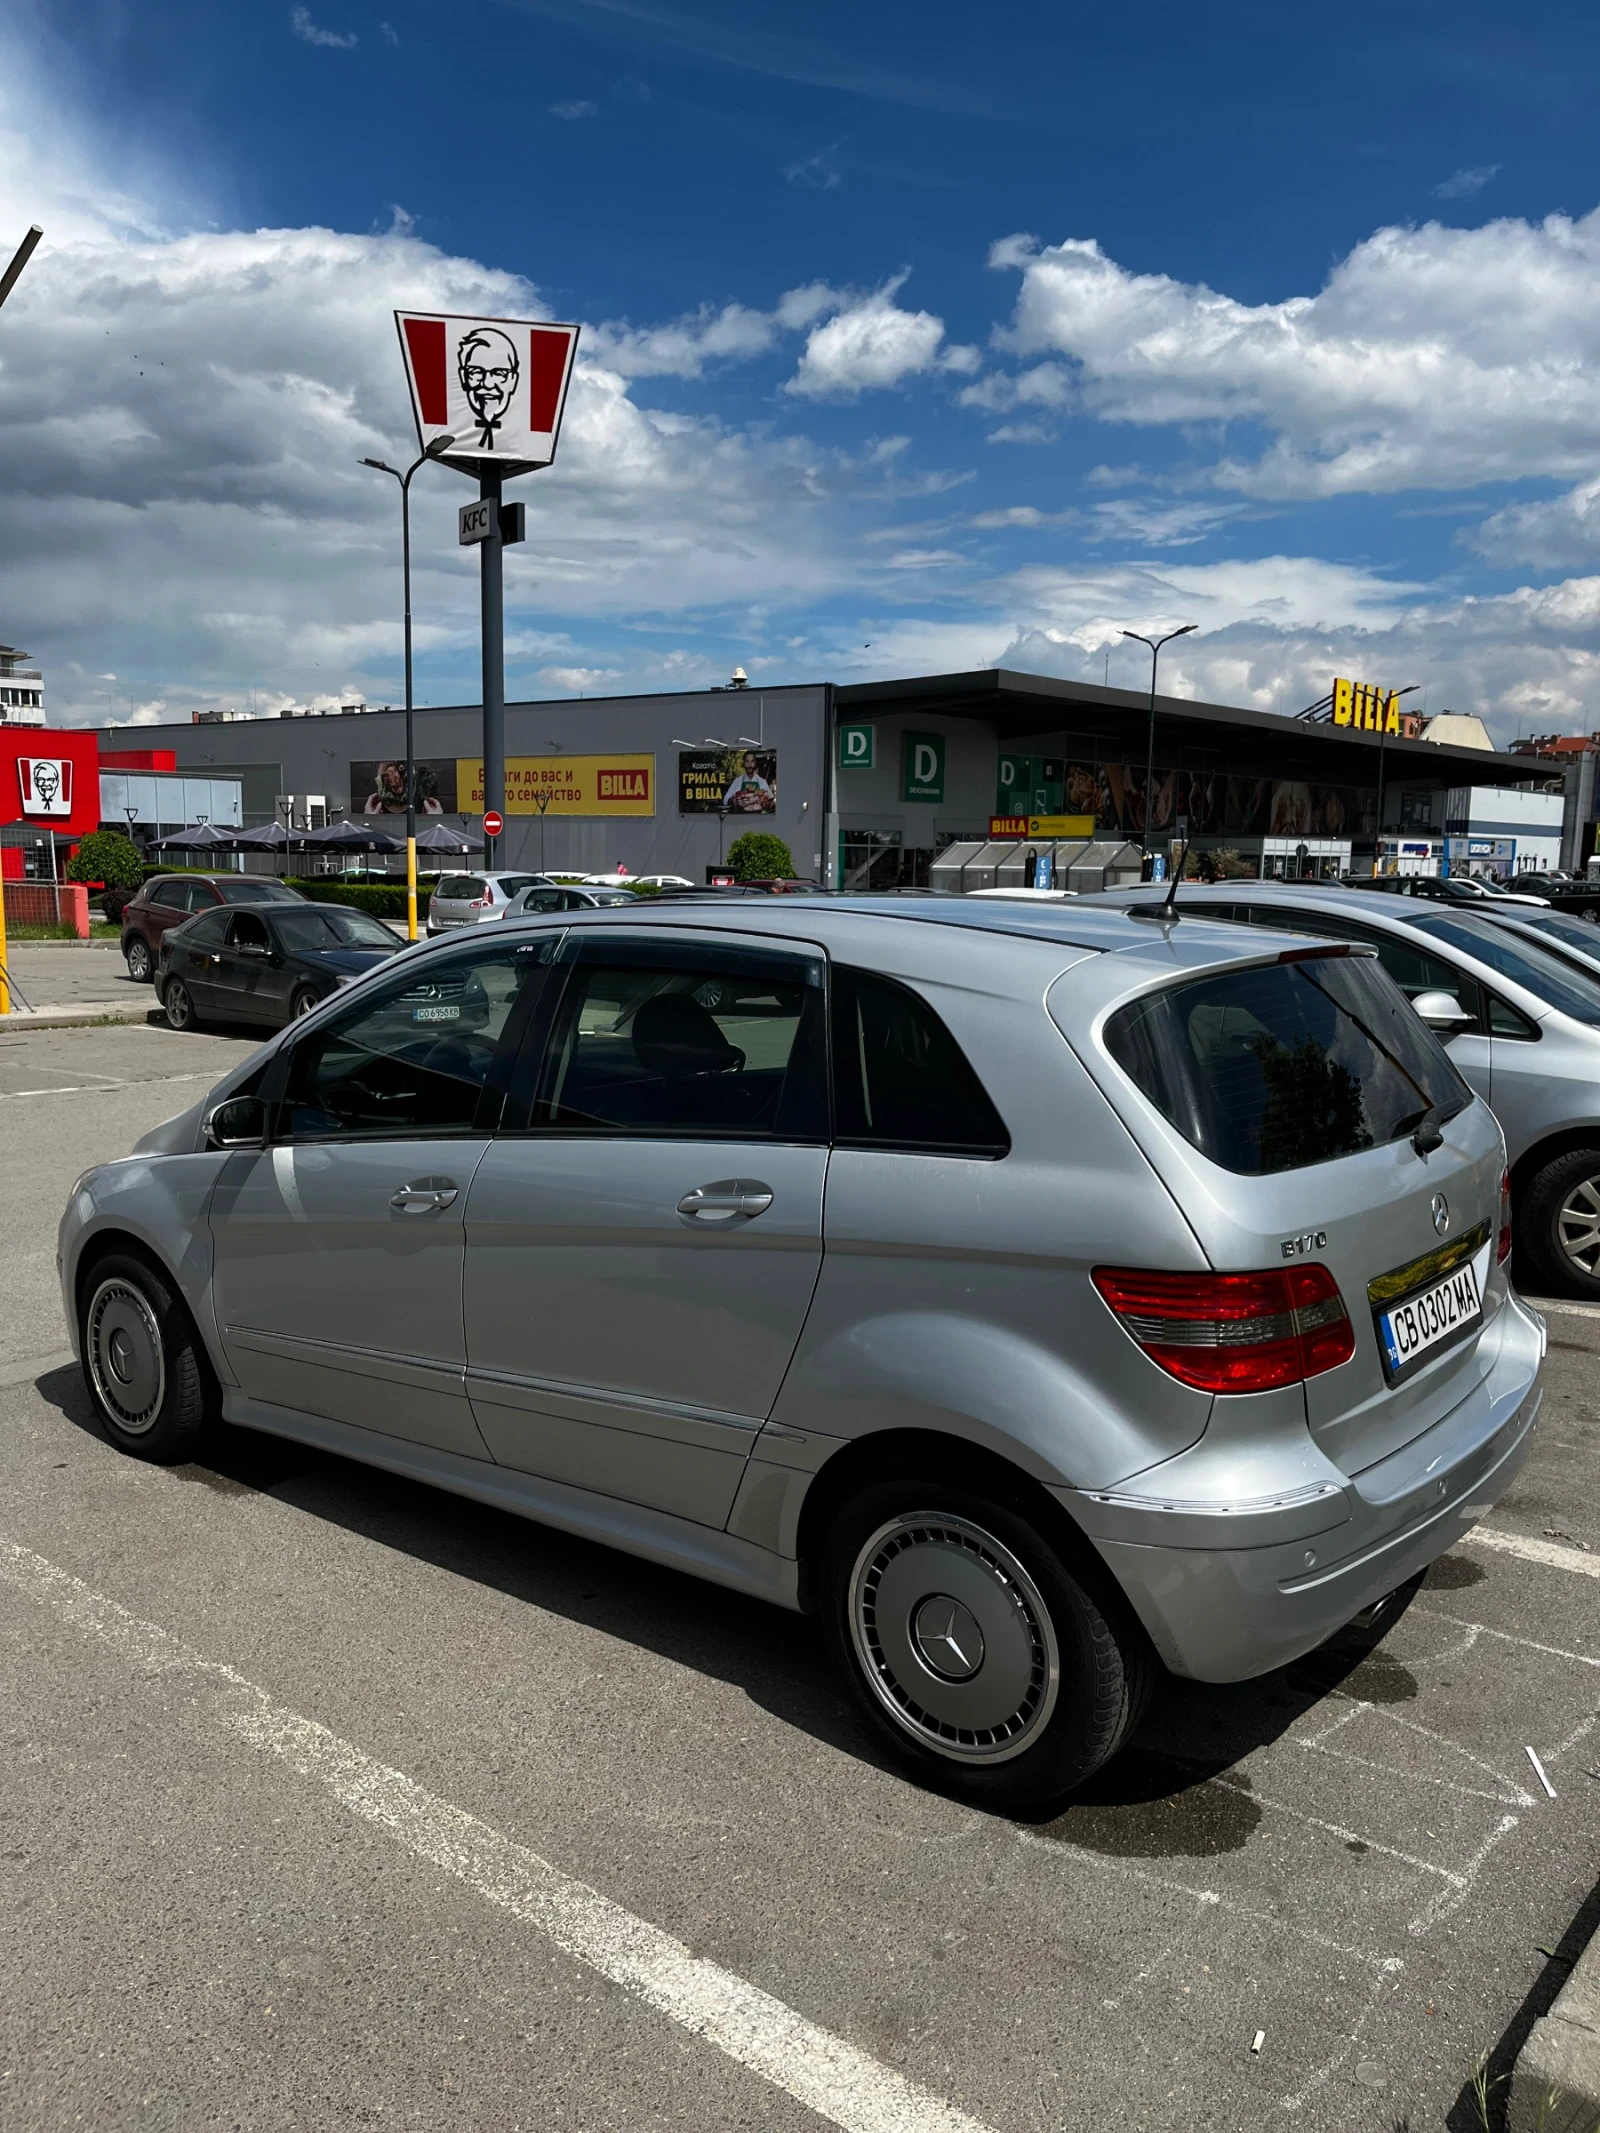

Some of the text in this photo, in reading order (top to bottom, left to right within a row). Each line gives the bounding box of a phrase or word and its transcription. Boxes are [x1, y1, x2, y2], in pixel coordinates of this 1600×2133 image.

[462, 507, 487, 534] KFC
[1332, 677, 1400, 734] BILLA
[848, 731, 867, 757] D
[915, 744, 938, 783] D
[1001, 760, 1015, 786] D
[524, 770, 539, 785] до
[541, 769, 562, 782] вас
[565, 770, 573, 782] и
[601, 774, 645, 796] BILLA
[682, 772, 717, 784] ГРИЛА
[517, 785, 582, 801] семейство
[695, 787, 723, 800] BILLA
[909, 786, 940, 795] DEICHMANN
[992, 820, 1026, 833] BILLA
[1280, 1231, 1327, 1258] B170
